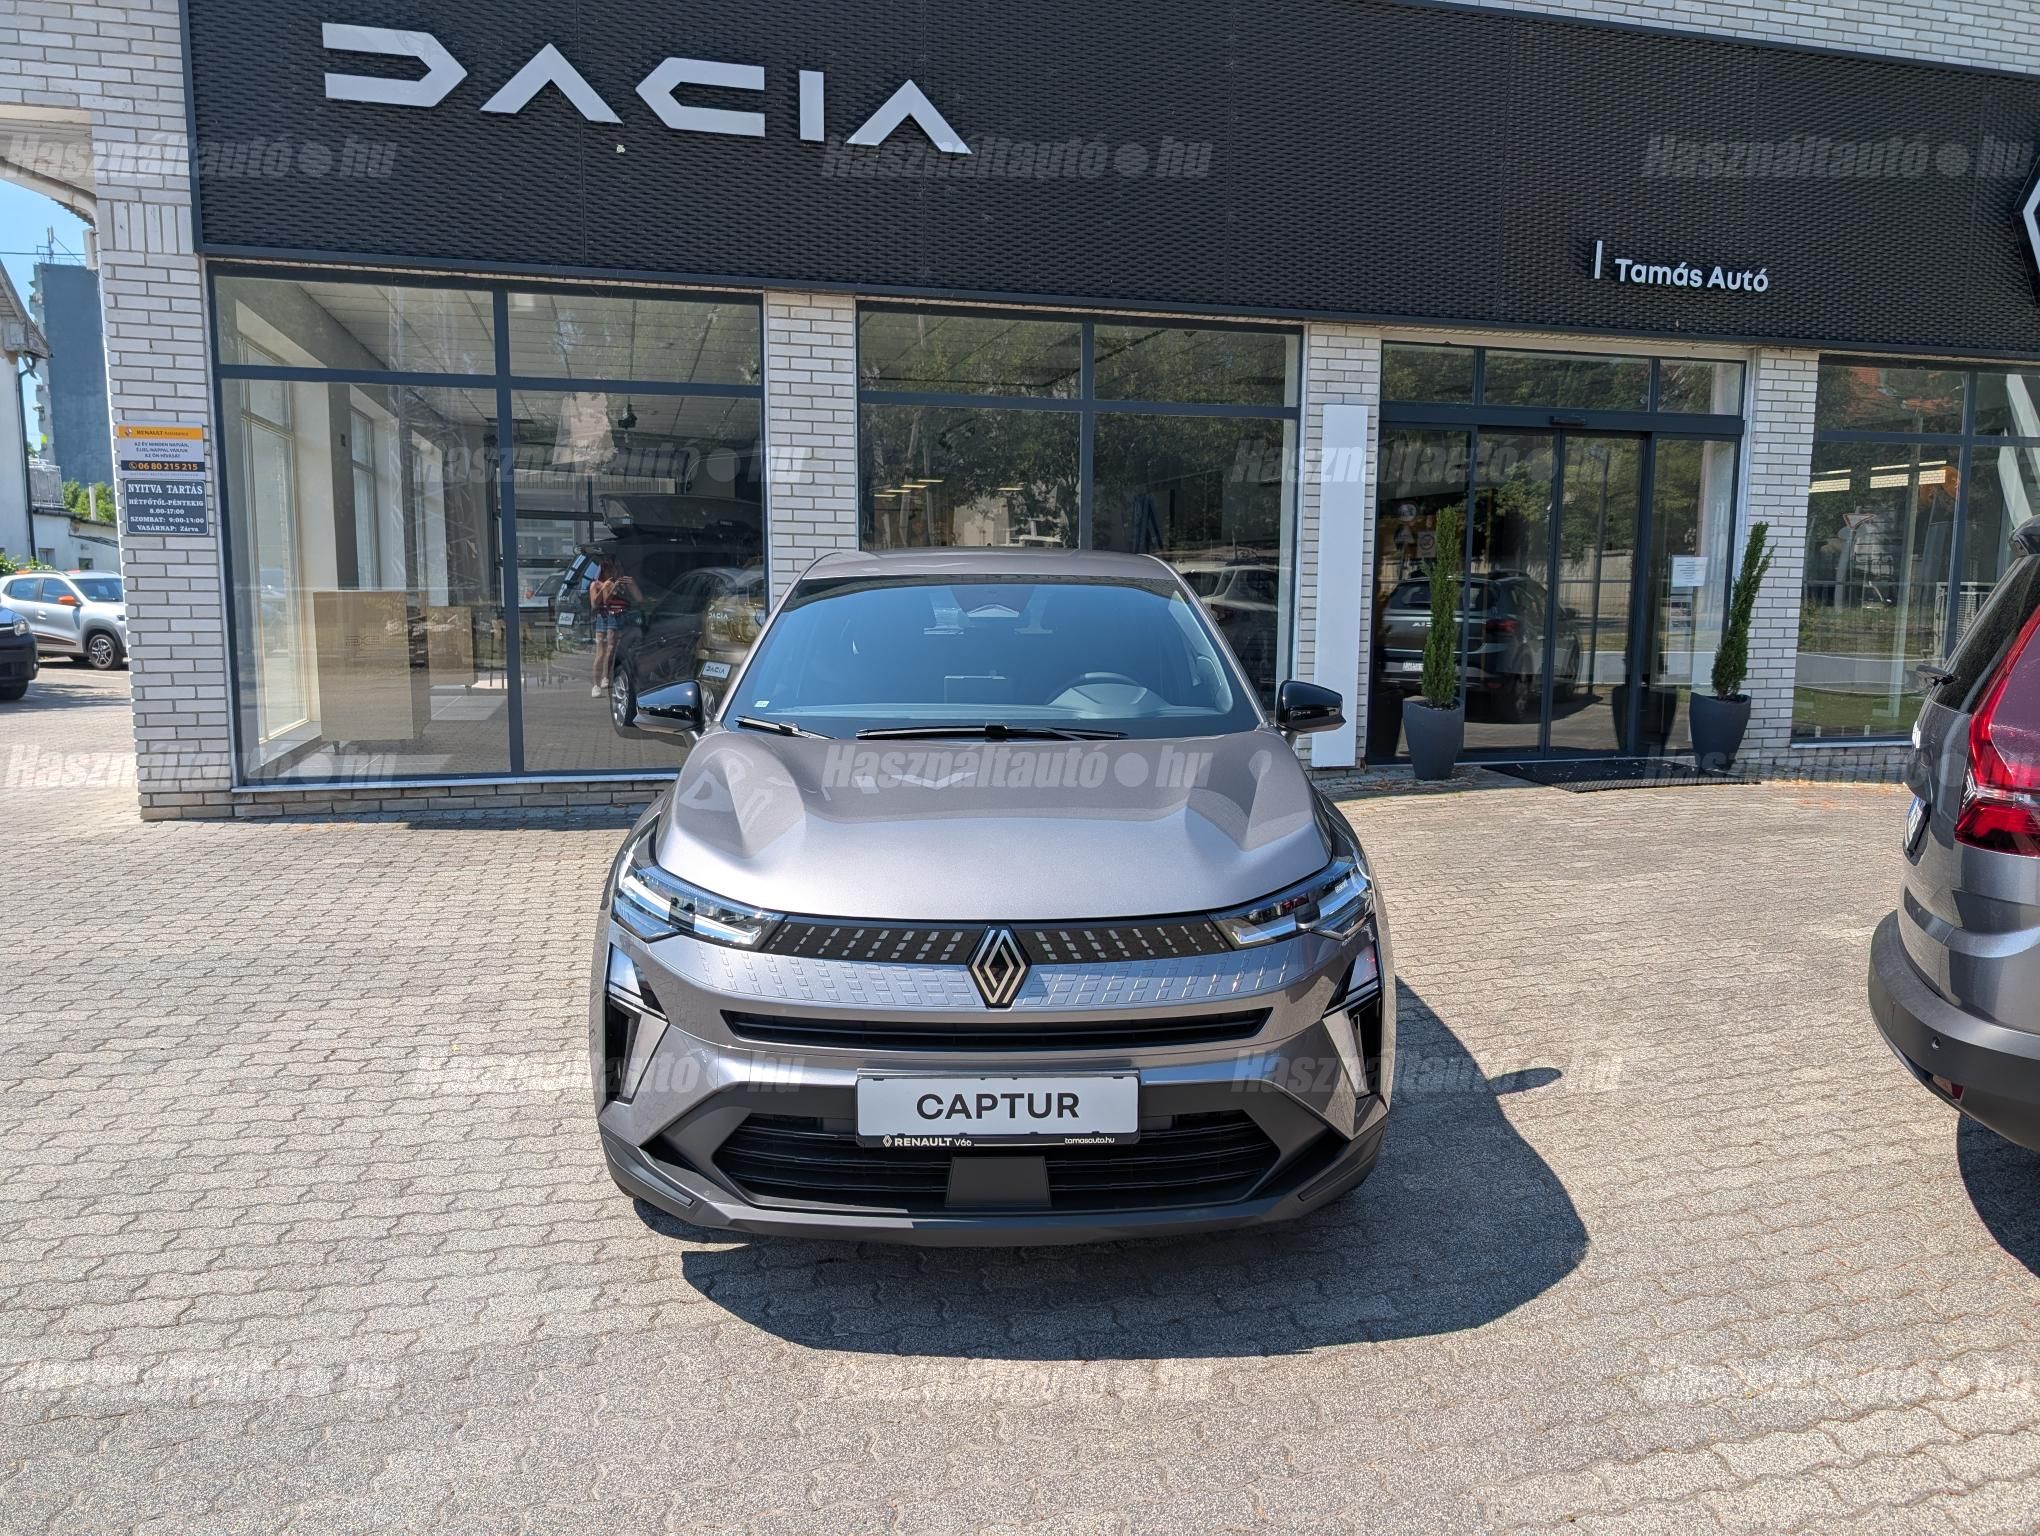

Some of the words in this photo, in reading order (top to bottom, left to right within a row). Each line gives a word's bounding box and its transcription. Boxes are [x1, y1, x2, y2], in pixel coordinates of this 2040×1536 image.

[322, 22, 973, 155] DACIA
[1615, 258, 1703, 289] Tamás
[1707, 266, 1769, 293] Autó
[138, 462, 150, 470] 06
[151, 462, 162, 470] 80
[164, 463, 180, 471] 215
[182, 463, 198, 471] 215
[128, 483, 162, 494] NYITVA
[166, 483, 203, 495] TARTÁS
[916, 1092, 1080, 1120] CAPTUR
[894, 1137, 952, 1147] RENAULT
[1064, 1136, 1115, 1144] tamasauto.hu
